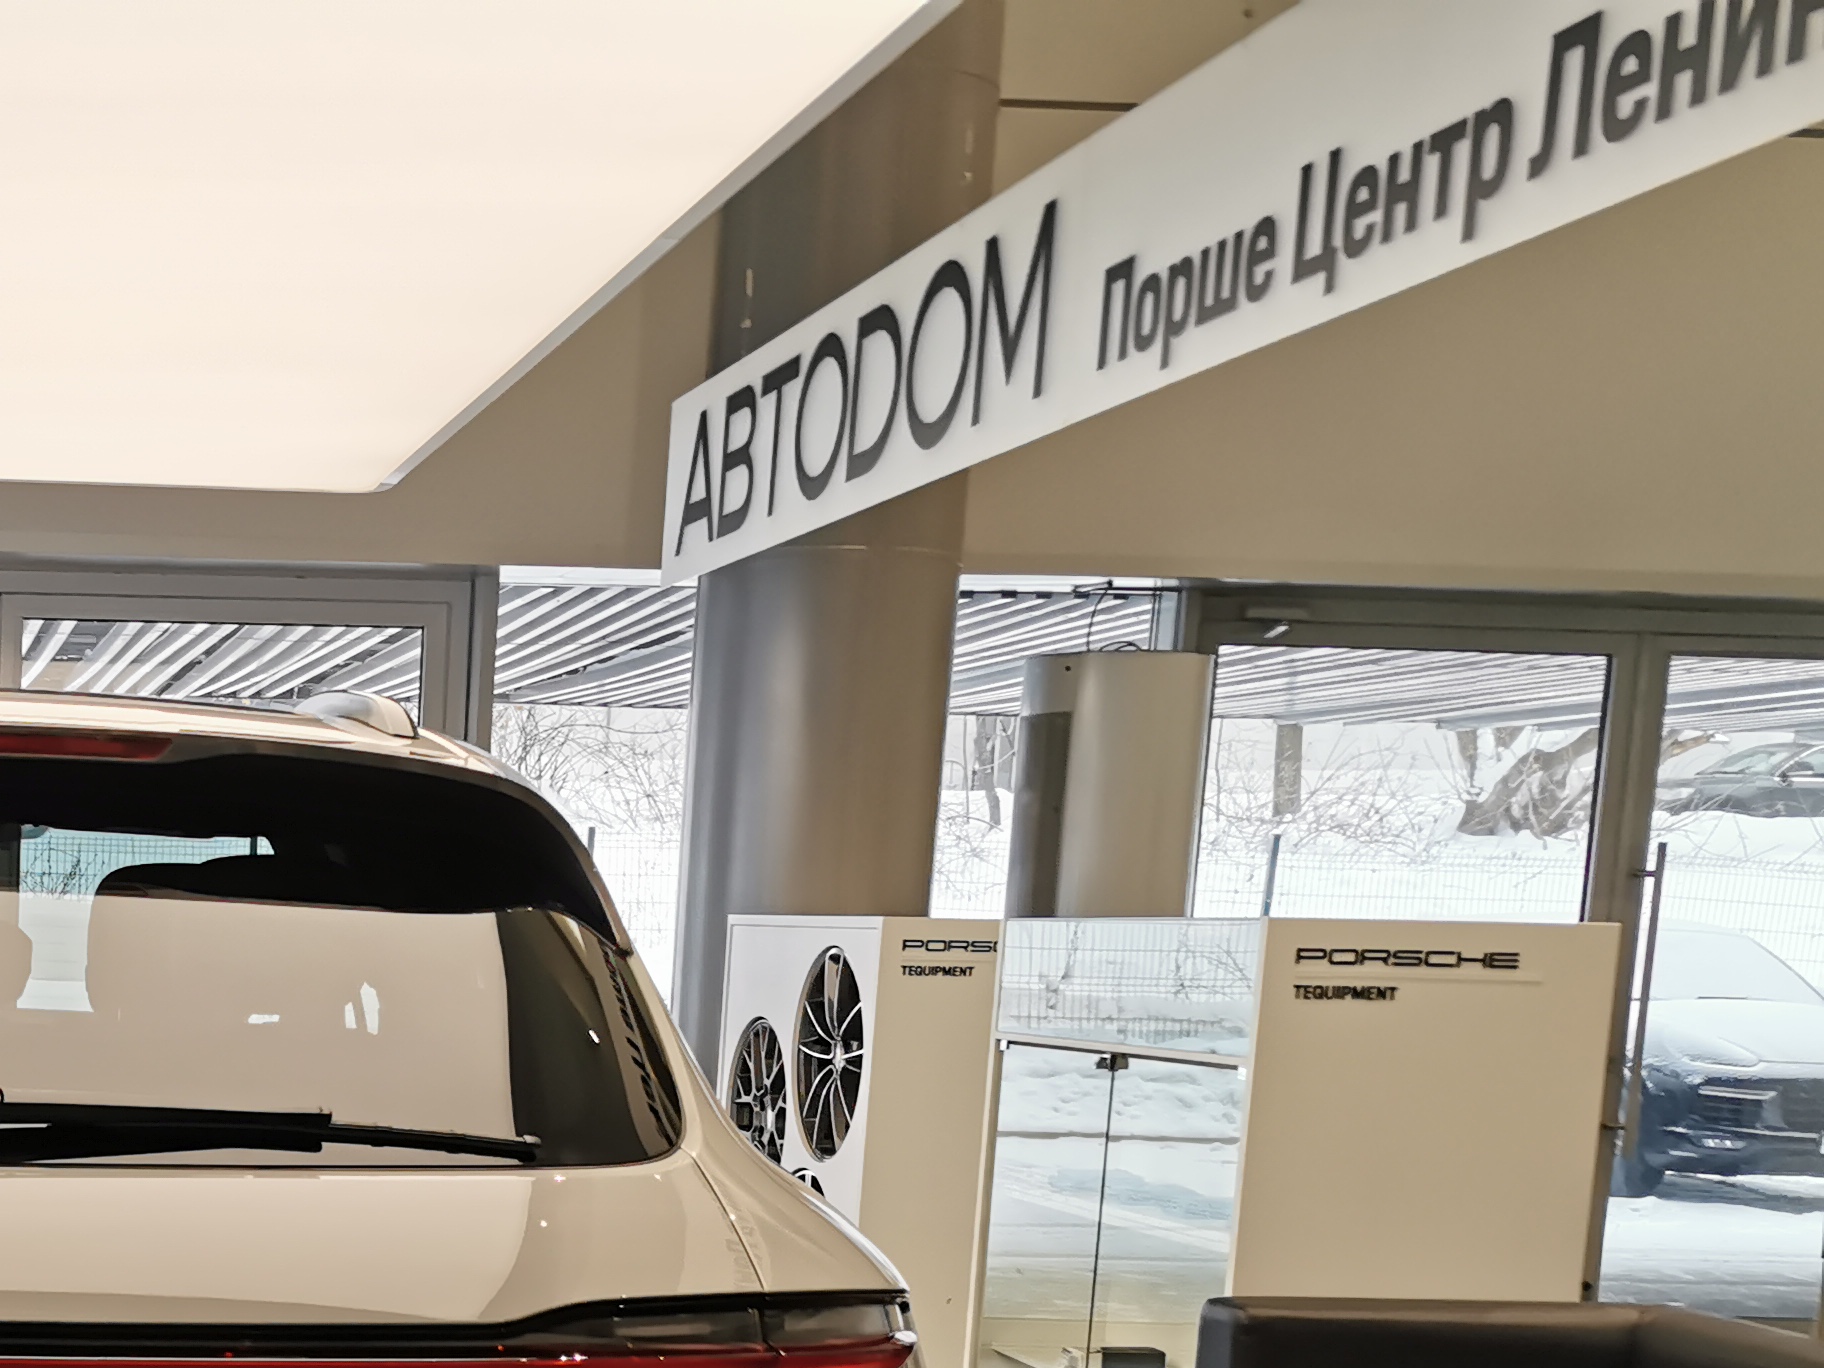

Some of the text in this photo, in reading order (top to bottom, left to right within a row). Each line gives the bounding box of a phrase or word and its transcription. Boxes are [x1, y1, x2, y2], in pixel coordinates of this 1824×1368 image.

[1095, 214, 1276, 370] Порше
[1290, 97, 1514, 296] Центр
[902, 939, 998, 953] PORS
[1295, 948, 1521, 969] PORSCHE
[901, 965, 974, 977] TEQUIPMENT
[1294, 984, 1399, 1001] TEQUIPMENT
